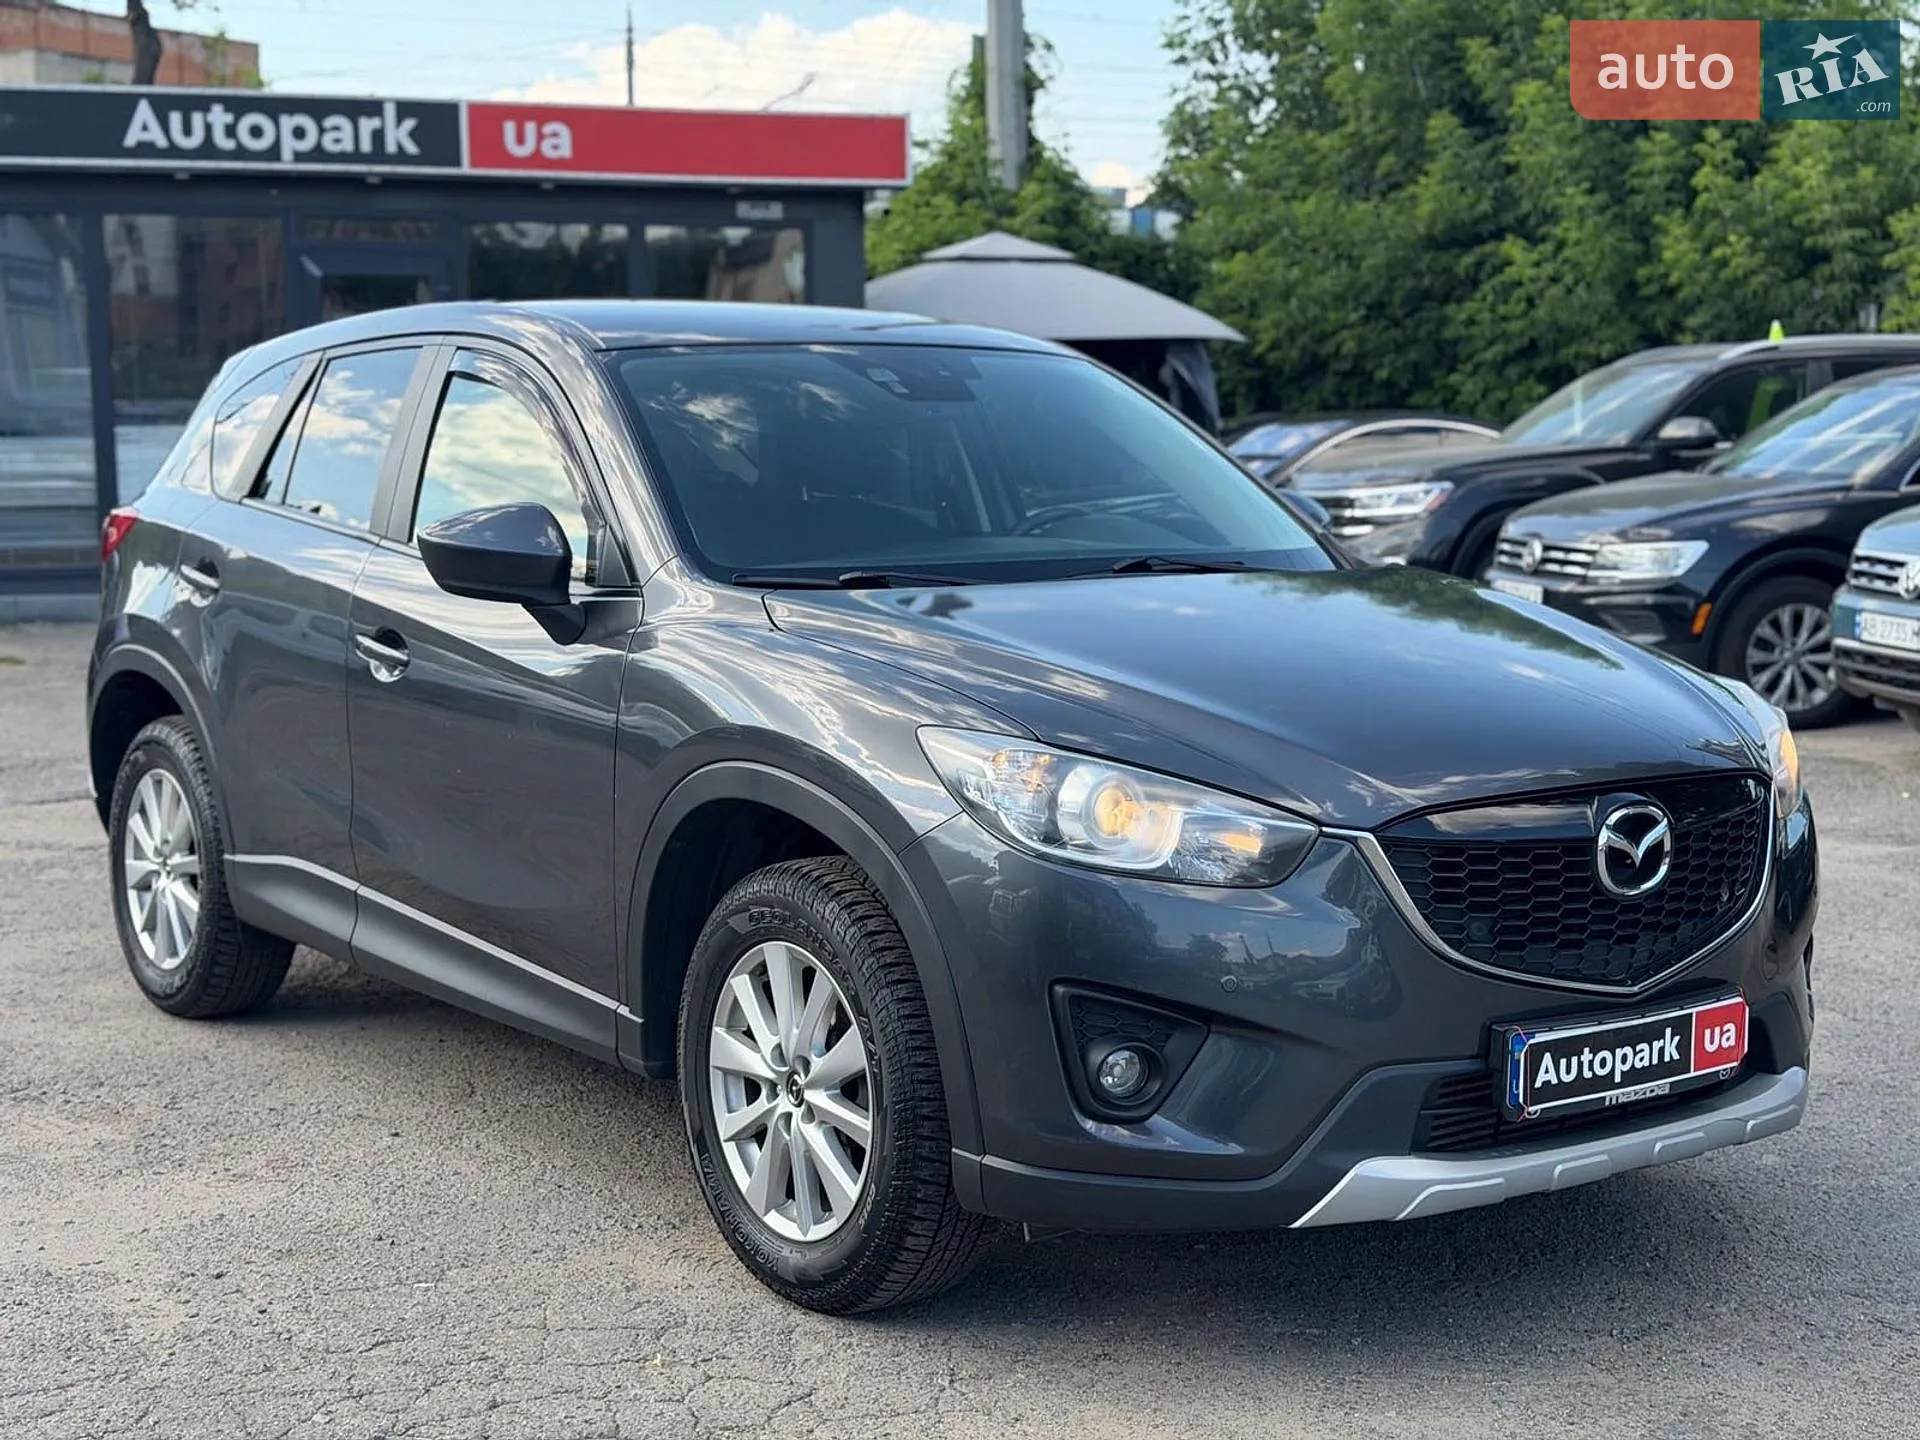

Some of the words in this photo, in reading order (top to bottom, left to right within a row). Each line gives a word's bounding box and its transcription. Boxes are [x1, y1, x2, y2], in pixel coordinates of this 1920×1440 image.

[123, 98, 420, 163] Autopark
[503, 119, 573, 158] ua
[748, 909, 857, 998] GEOLANDAR
[1534, 1027, 1681, 1088] Autopark
[1703, 1022, 1737, 1053] ua
[700, 1152, 778, 1271] YOKOHAMA
